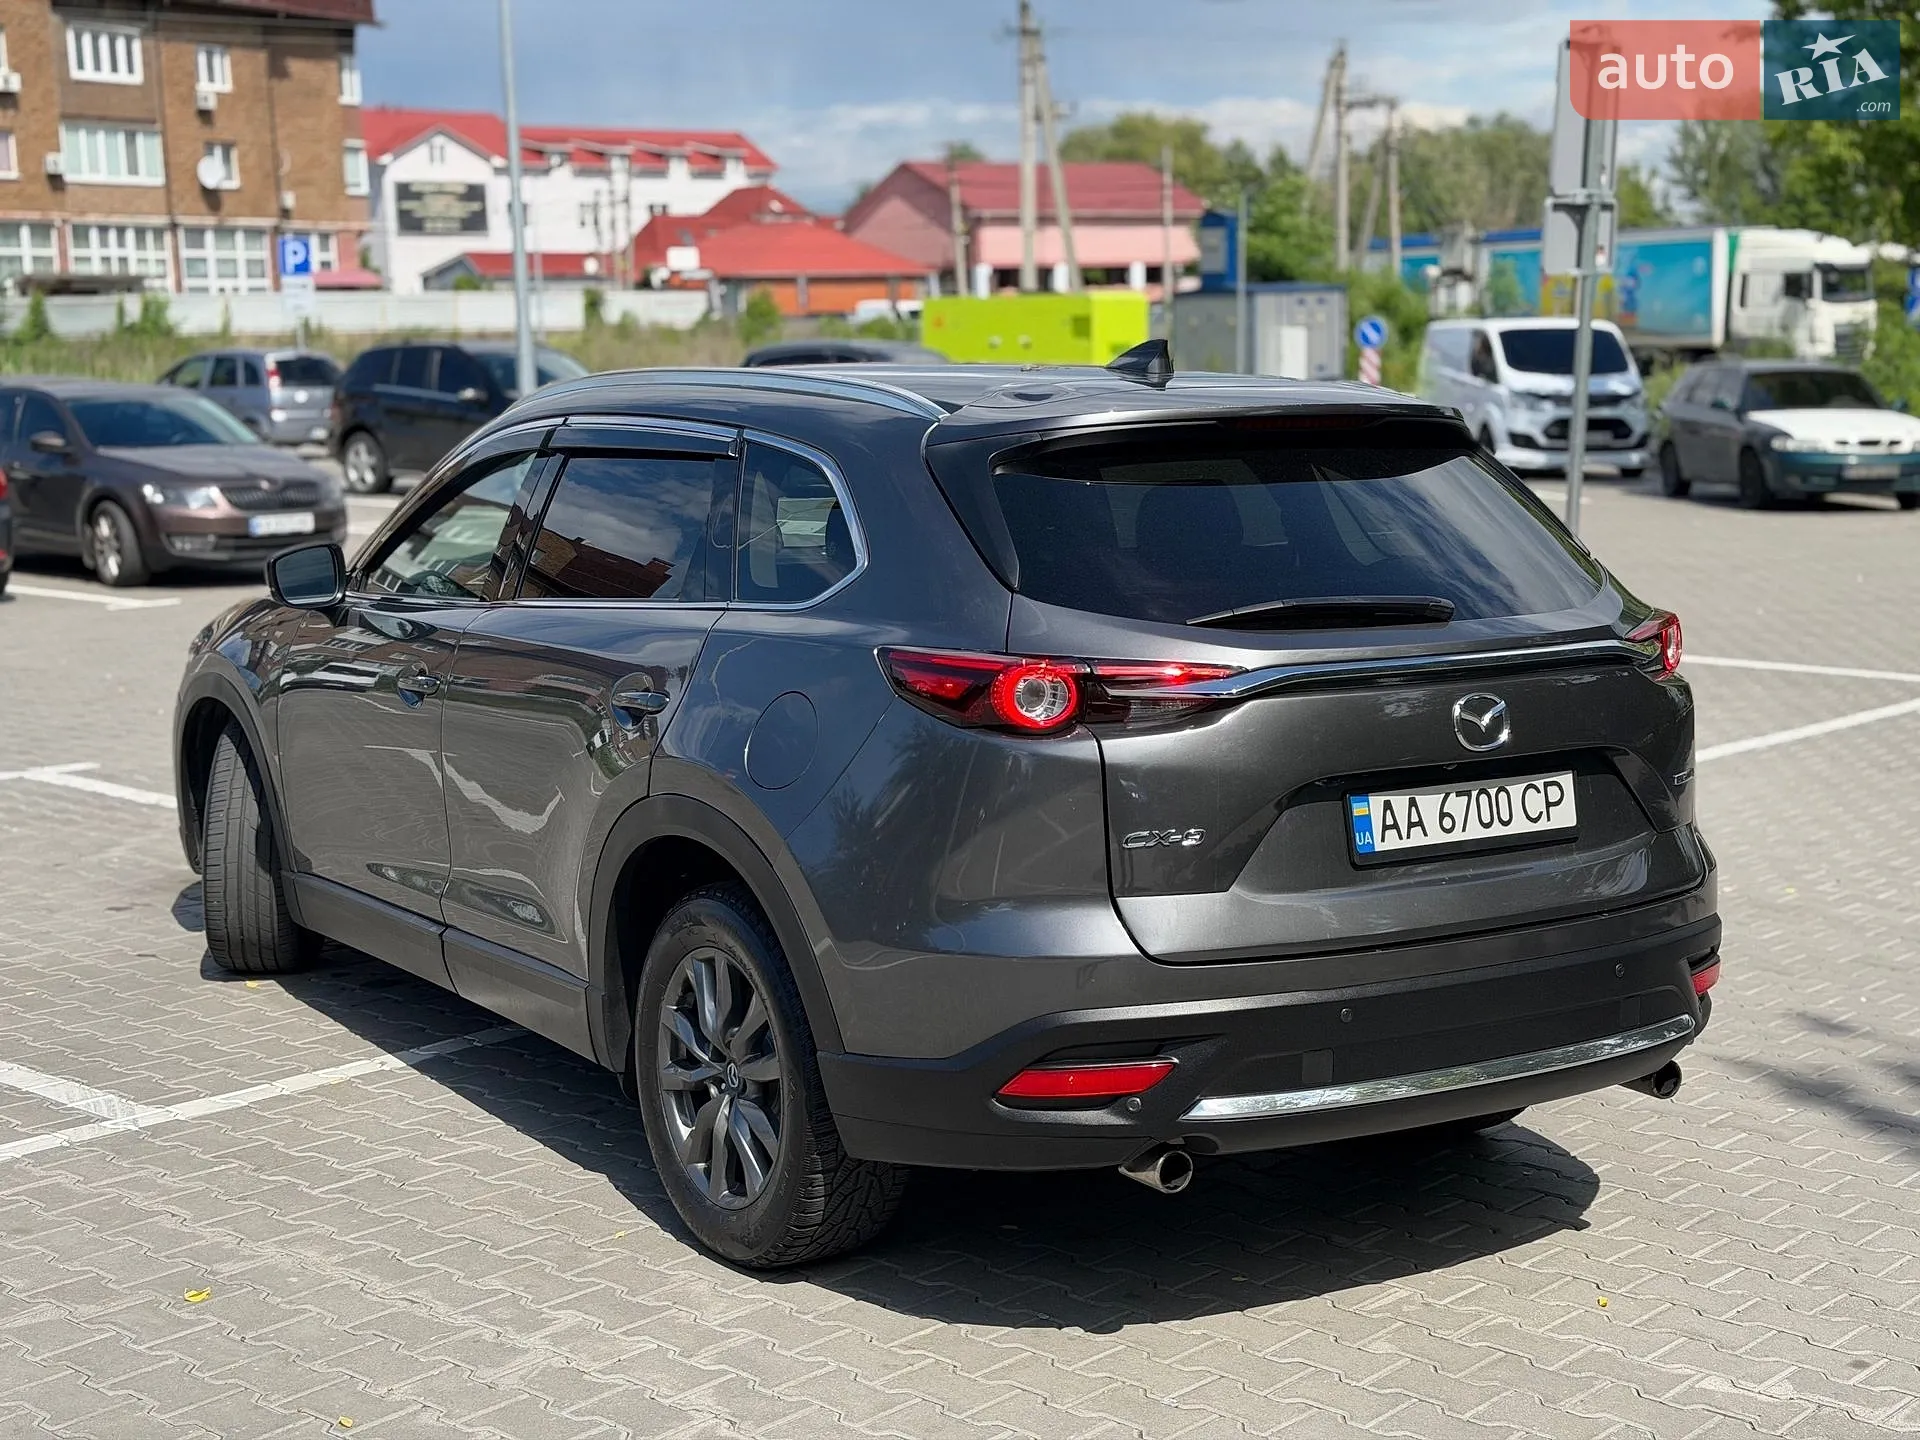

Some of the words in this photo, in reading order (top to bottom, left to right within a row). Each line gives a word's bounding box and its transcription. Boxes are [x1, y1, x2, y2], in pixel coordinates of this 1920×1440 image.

[284, 239, 308, 274] P
[1380, 796, 1429, 843] AA
[1438, 785, 1514, 834] 6700
[1521, 780, 1565, 824] CP
[1122, 828, 1207, 849] CX-9
[1355, 832, 1373, 845] UA
